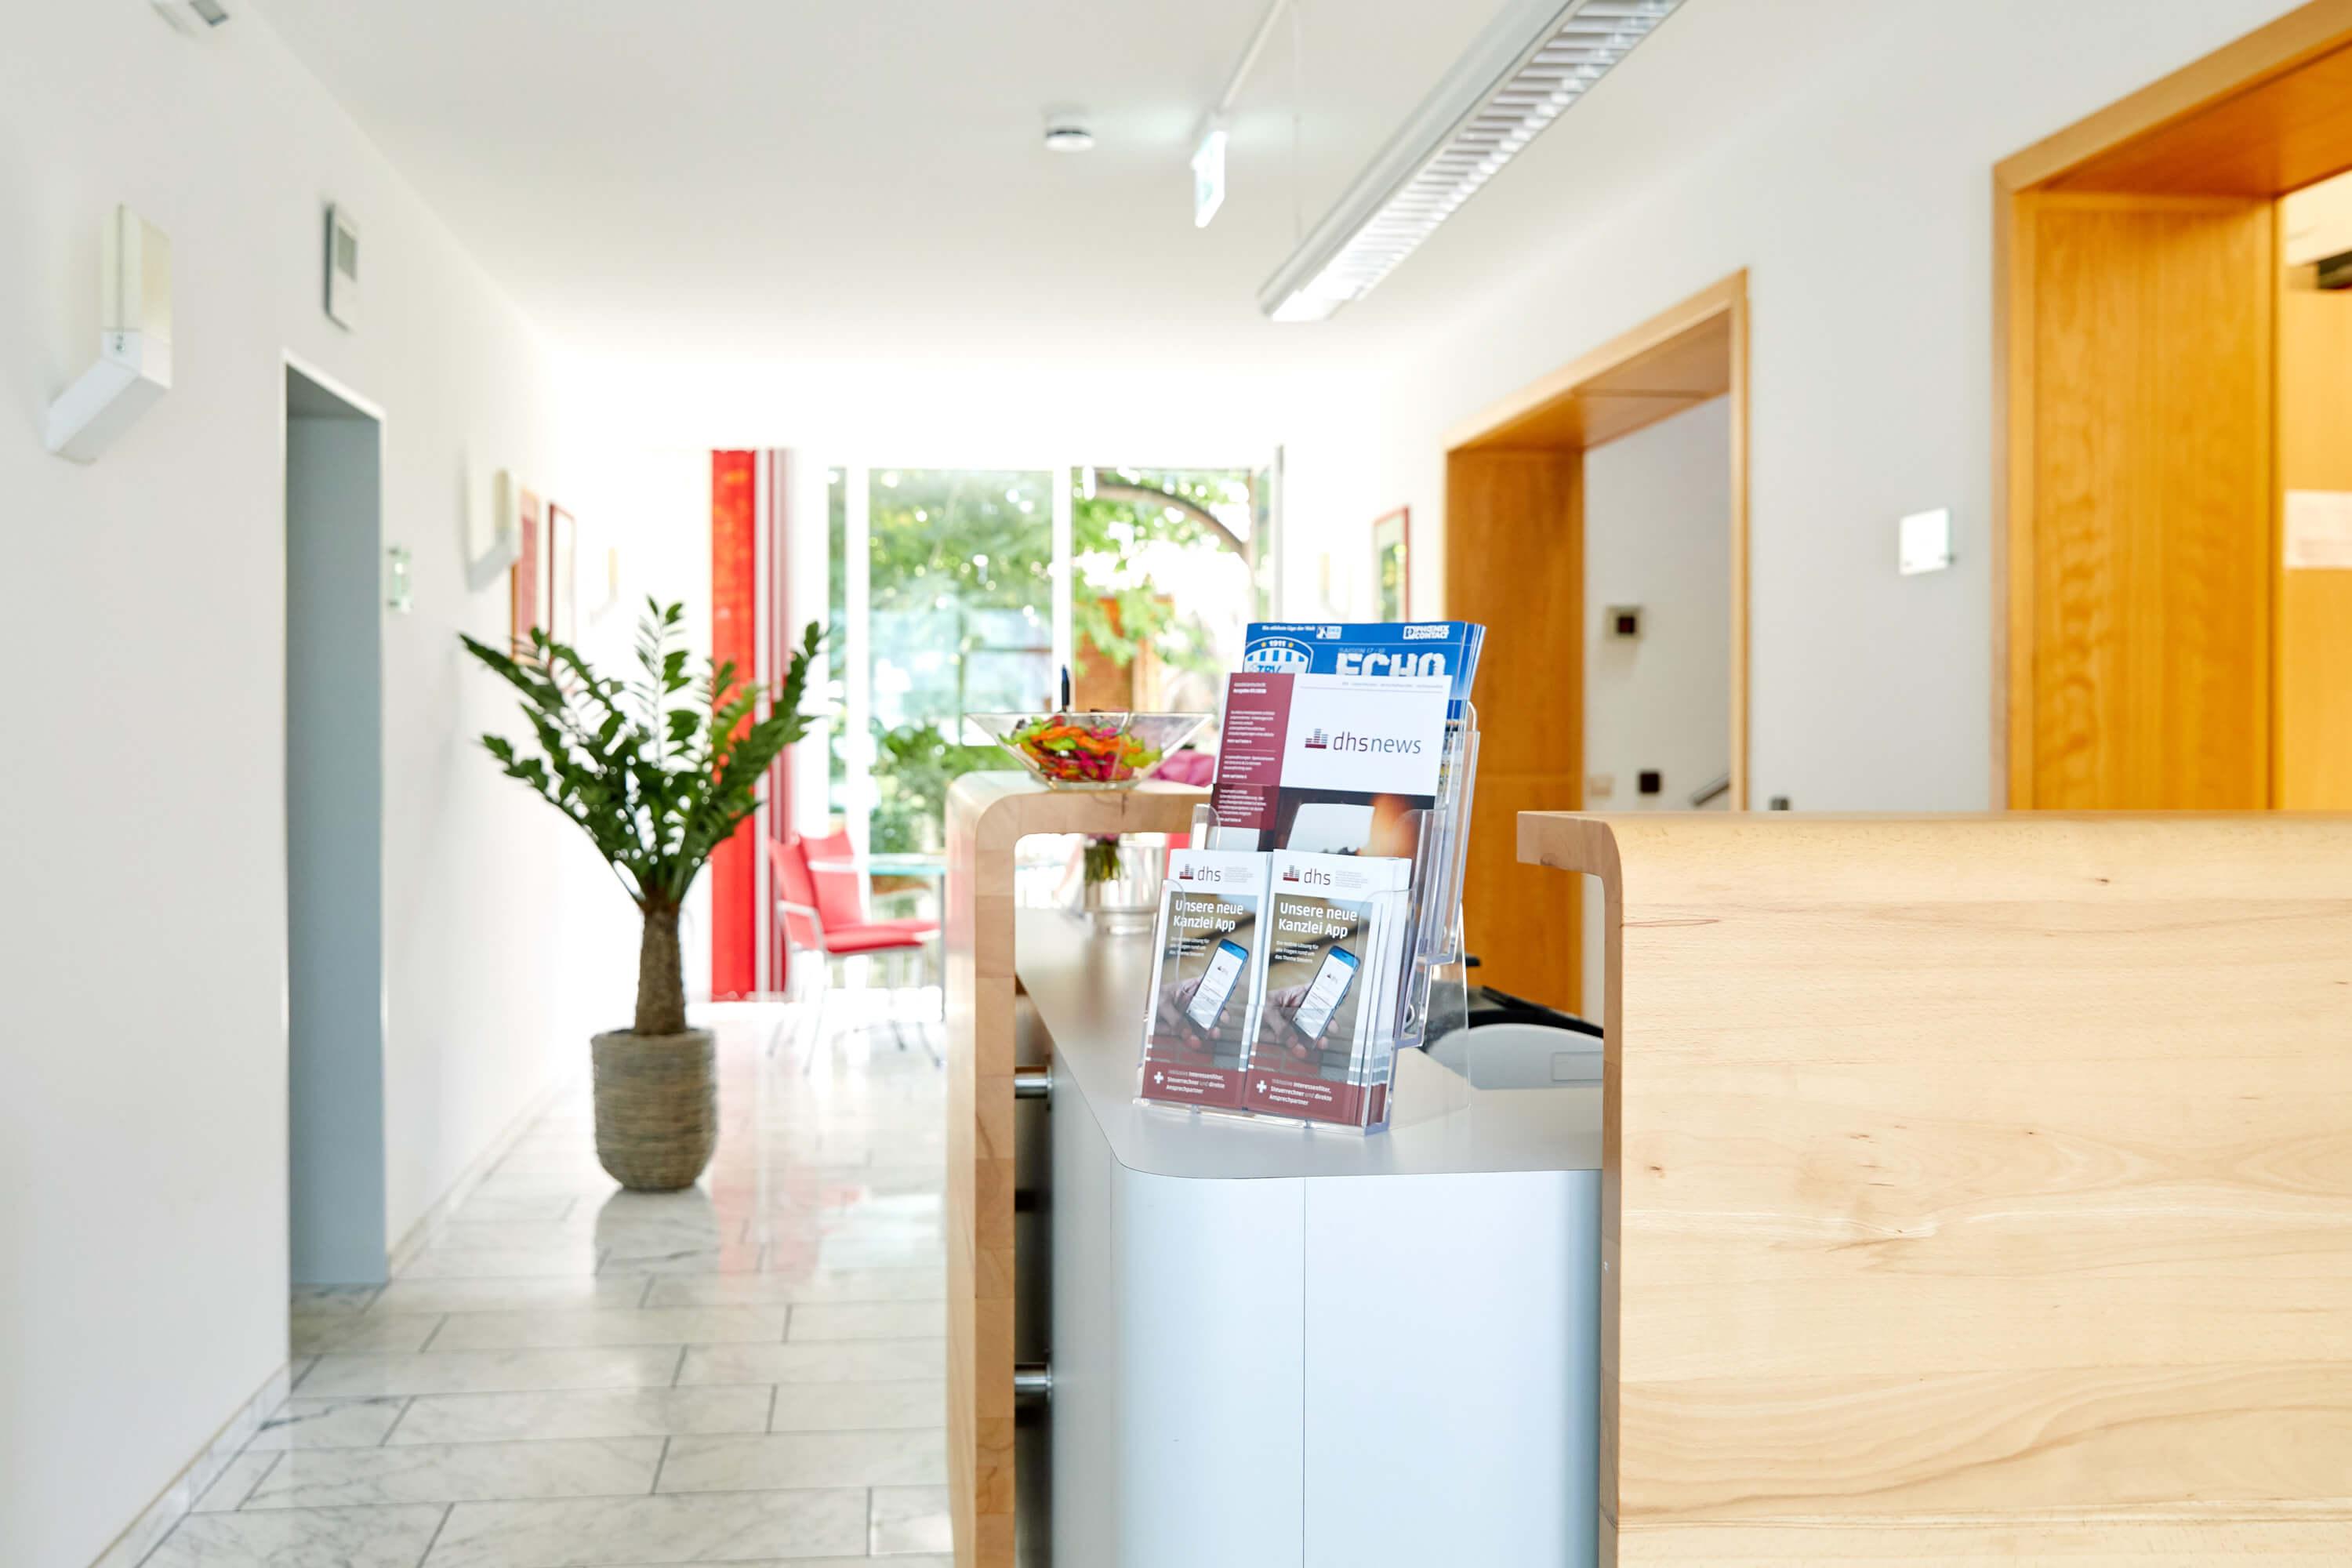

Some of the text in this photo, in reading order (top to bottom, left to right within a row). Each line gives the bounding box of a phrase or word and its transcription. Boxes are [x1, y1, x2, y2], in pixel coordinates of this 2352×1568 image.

[1335, 652, 1446, 677] ECHO
[1197, 866, 1221, 882] dhs
[1304, 868, 1330, 885] dhs
[1175, 899, 1244, 915] Unsere neue
[1279, 902, 1358, 921] Unsere neue
[1173, 915, 1236, 932] Kanzlei App
[1278, 918, 1348, 939] Kanzlei App
